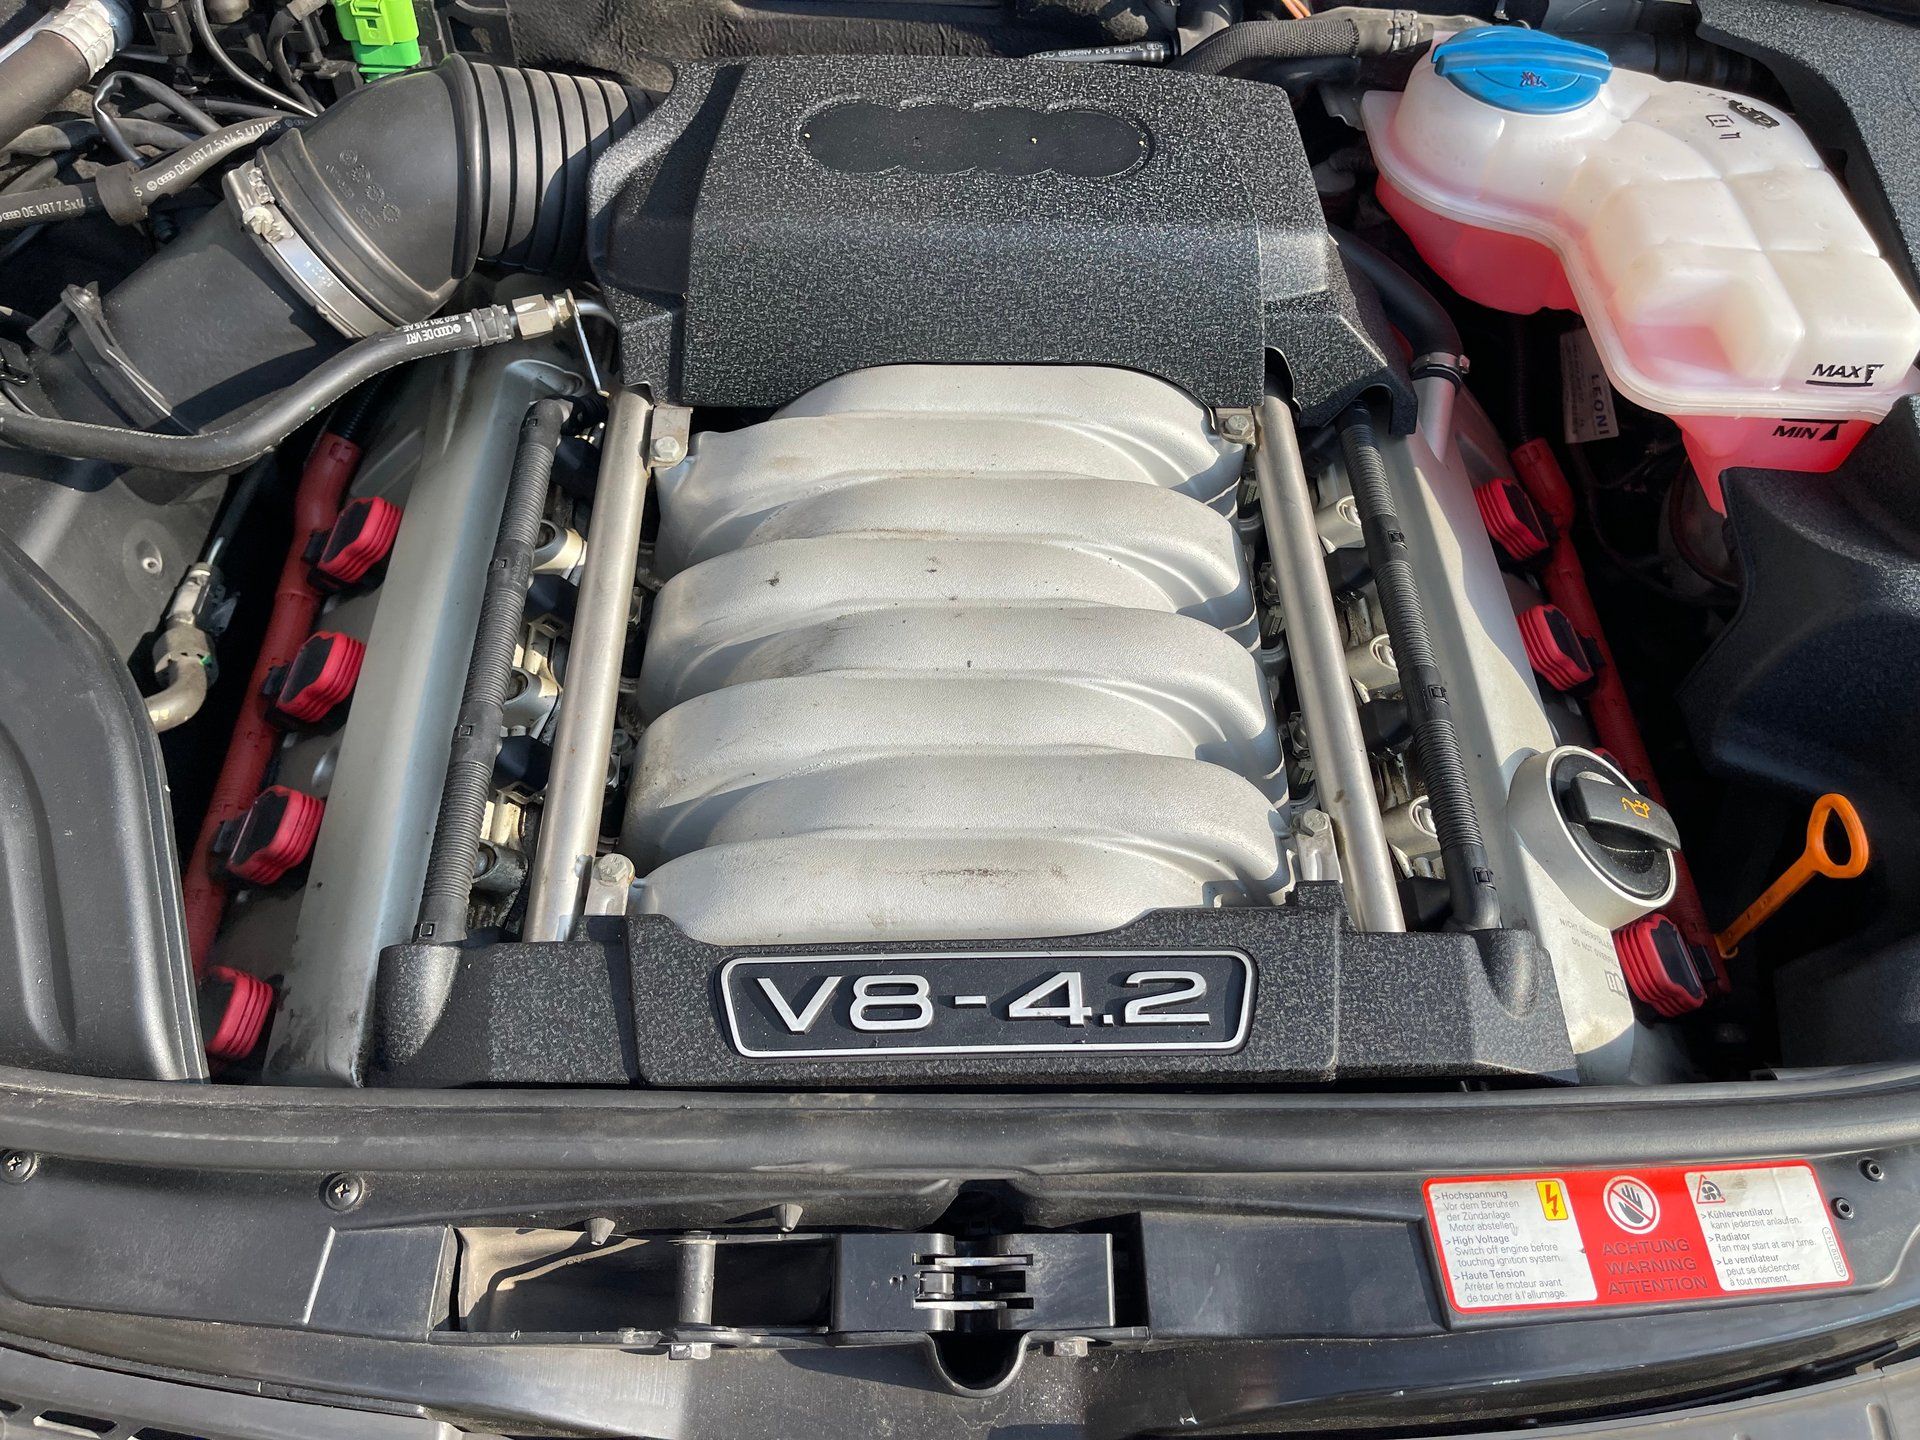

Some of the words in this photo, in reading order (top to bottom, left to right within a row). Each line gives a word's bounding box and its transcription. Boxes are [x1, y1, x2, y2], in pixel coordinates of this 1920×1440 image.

[175, 160, 191, 176] DE
[187, 147, 207, 166] VRT
[21, 205, 37, 218] DE
[36, 201, 55, 214] VRT
[406, 331, 422, 345] VRT
[422, 329, 434, 342] DE
[1812, 364, 1865, 378] MAX
[1592, 374, 1610, 435] LEONI
[1772, 425, 1820, 439] MIN
[1441, 1190, 1508, 1200] Hochspannung
[1443, 1202, 1458, 1211] Vor
[1460, 1201, 1479, 1210] dem
[1446, 1213, 1460, 1221] der
[1462, 1211, 1511, 1221] Zündanlage
[1707, 1207, 1774, 1219] Kühlerventilator
[1449, 1223, 1475, 1232] Motor
[1710, 1220, 1730, 1230] kann
[1731, 1219, 1765, 1230] jederzeit
[1766, 1216, 1802, 1226] anlaufen.
[1452, 1236, 1474, 1247] High
[1476, 1234, 1510, 1245] Voltage
[1714, 1232, 1751, 1242] Radiator
[1454, 1246, 1485, 1256] Switch
[1487, 1245, 1498, 1254] off
[1500, 1244, 1529, 1255] engine
[1531, 1243, 1558, 1252] before
[1603, 1238, 1690, 1256] ACHTUNG
[1733, 1243, 1750, 1252] may
[1752, 1241, 1770, 1250] start
[1771, 1240, 1780, 1249] at
[1781, 1240, 1795, 1249] any
[1458, 1258, 1495, 1268] touching
[1497, 1256, 1528, 1267] ignition
[1722, 1256, 1734, 1265] Le
[1734, 1253, 1779, 1264] ventilateur
[1605, 1257, 1697, 1275] WARNING
[1726, 1267, 1745, 1277] peut
[1746, 1266, 1756, 1275] se
[1758, 1263, 1801, 1273] déclencher
[1460, 1270, 1489, 1281] Haute
[1489, 1269, 1526, 1279] Tension
[1736, 1276, 1752, 1286] tout
[1496, 1281, 1504, 1290] le
[1506, 1280, 1537, 1289] moteur
[1539, 1278, 1562, 1288] avant
[1608, 1276, 1708, 1295] ATTENTION
[1466, 1293, 1478, 1303] de
[1480, 1292, 1513, 1301] toucher
[1515, 1290, 1521, 1300] à
